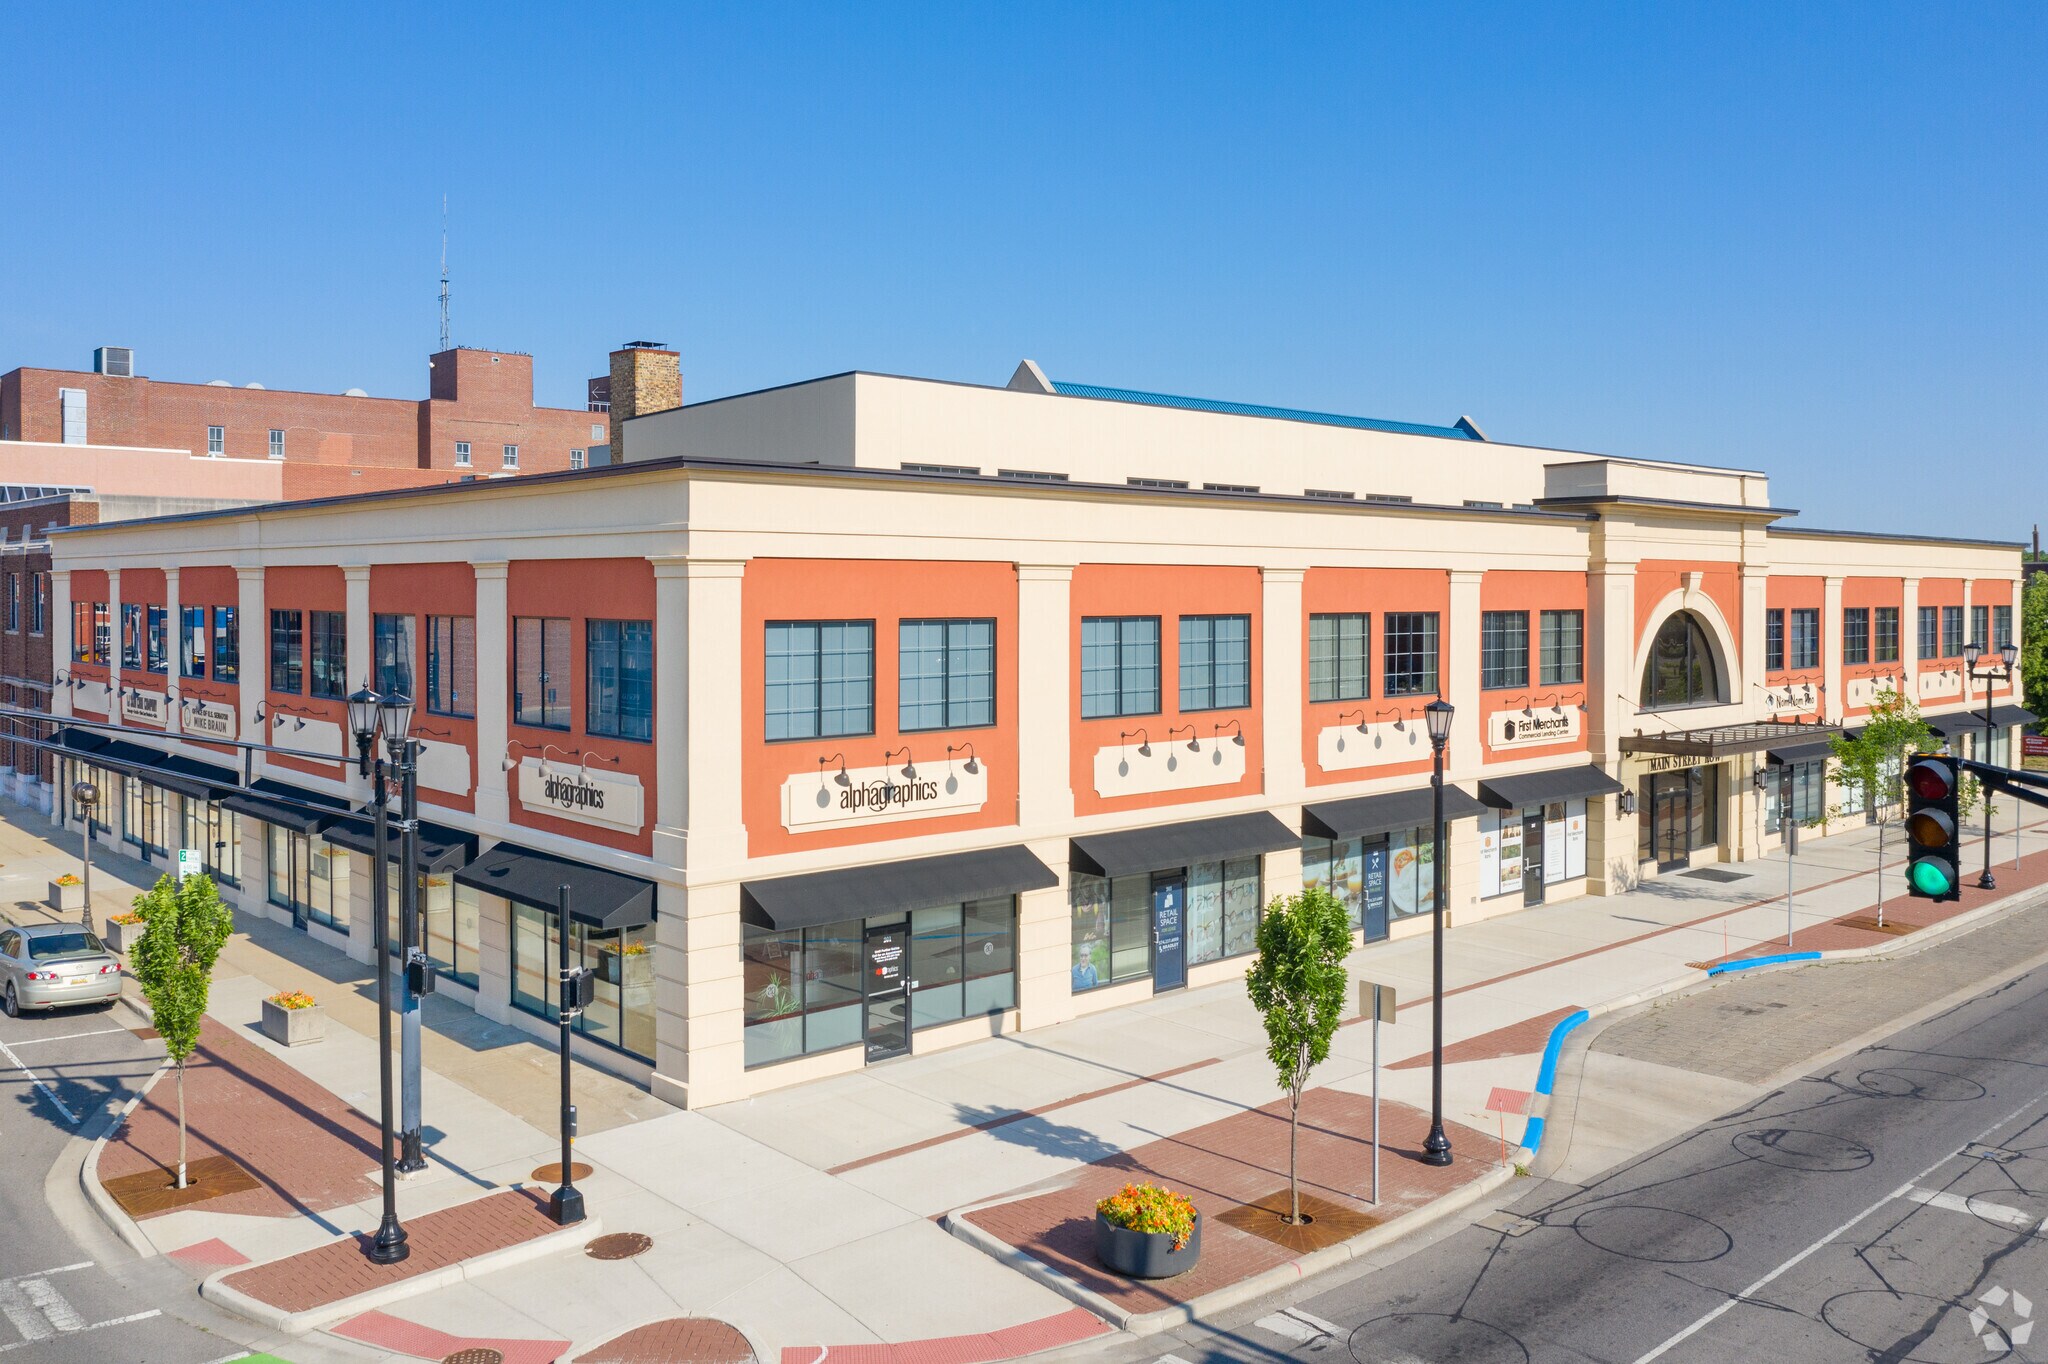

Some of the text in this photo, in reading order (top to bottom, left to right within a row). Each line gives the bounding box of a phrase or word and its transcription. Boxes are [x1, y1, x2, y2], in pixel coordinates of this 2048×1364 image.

[194, 717, 227, 734] MIKE BRAUN
[1518, 717, 1569, 732] First Merchants
[1518, 731, 1541, 740] Commercial
[1542, 730, 1556, 738] Lending
[1650, 757, 1670, 771] MAIN
[1673, 755, 1701, 768] STREET
[545, 774, 604, 811] alphagraphics
[840, 777, 938, 813] alphagraphics
[181, 852, 186, 860] 2
[1368, 871, 1383, 880] RETAIL
[1368, 878, 1382, 887] SPACE
[1160, 909, 1178, 919] RETAIL
[1160, 917, 1177, 926] SPACE
